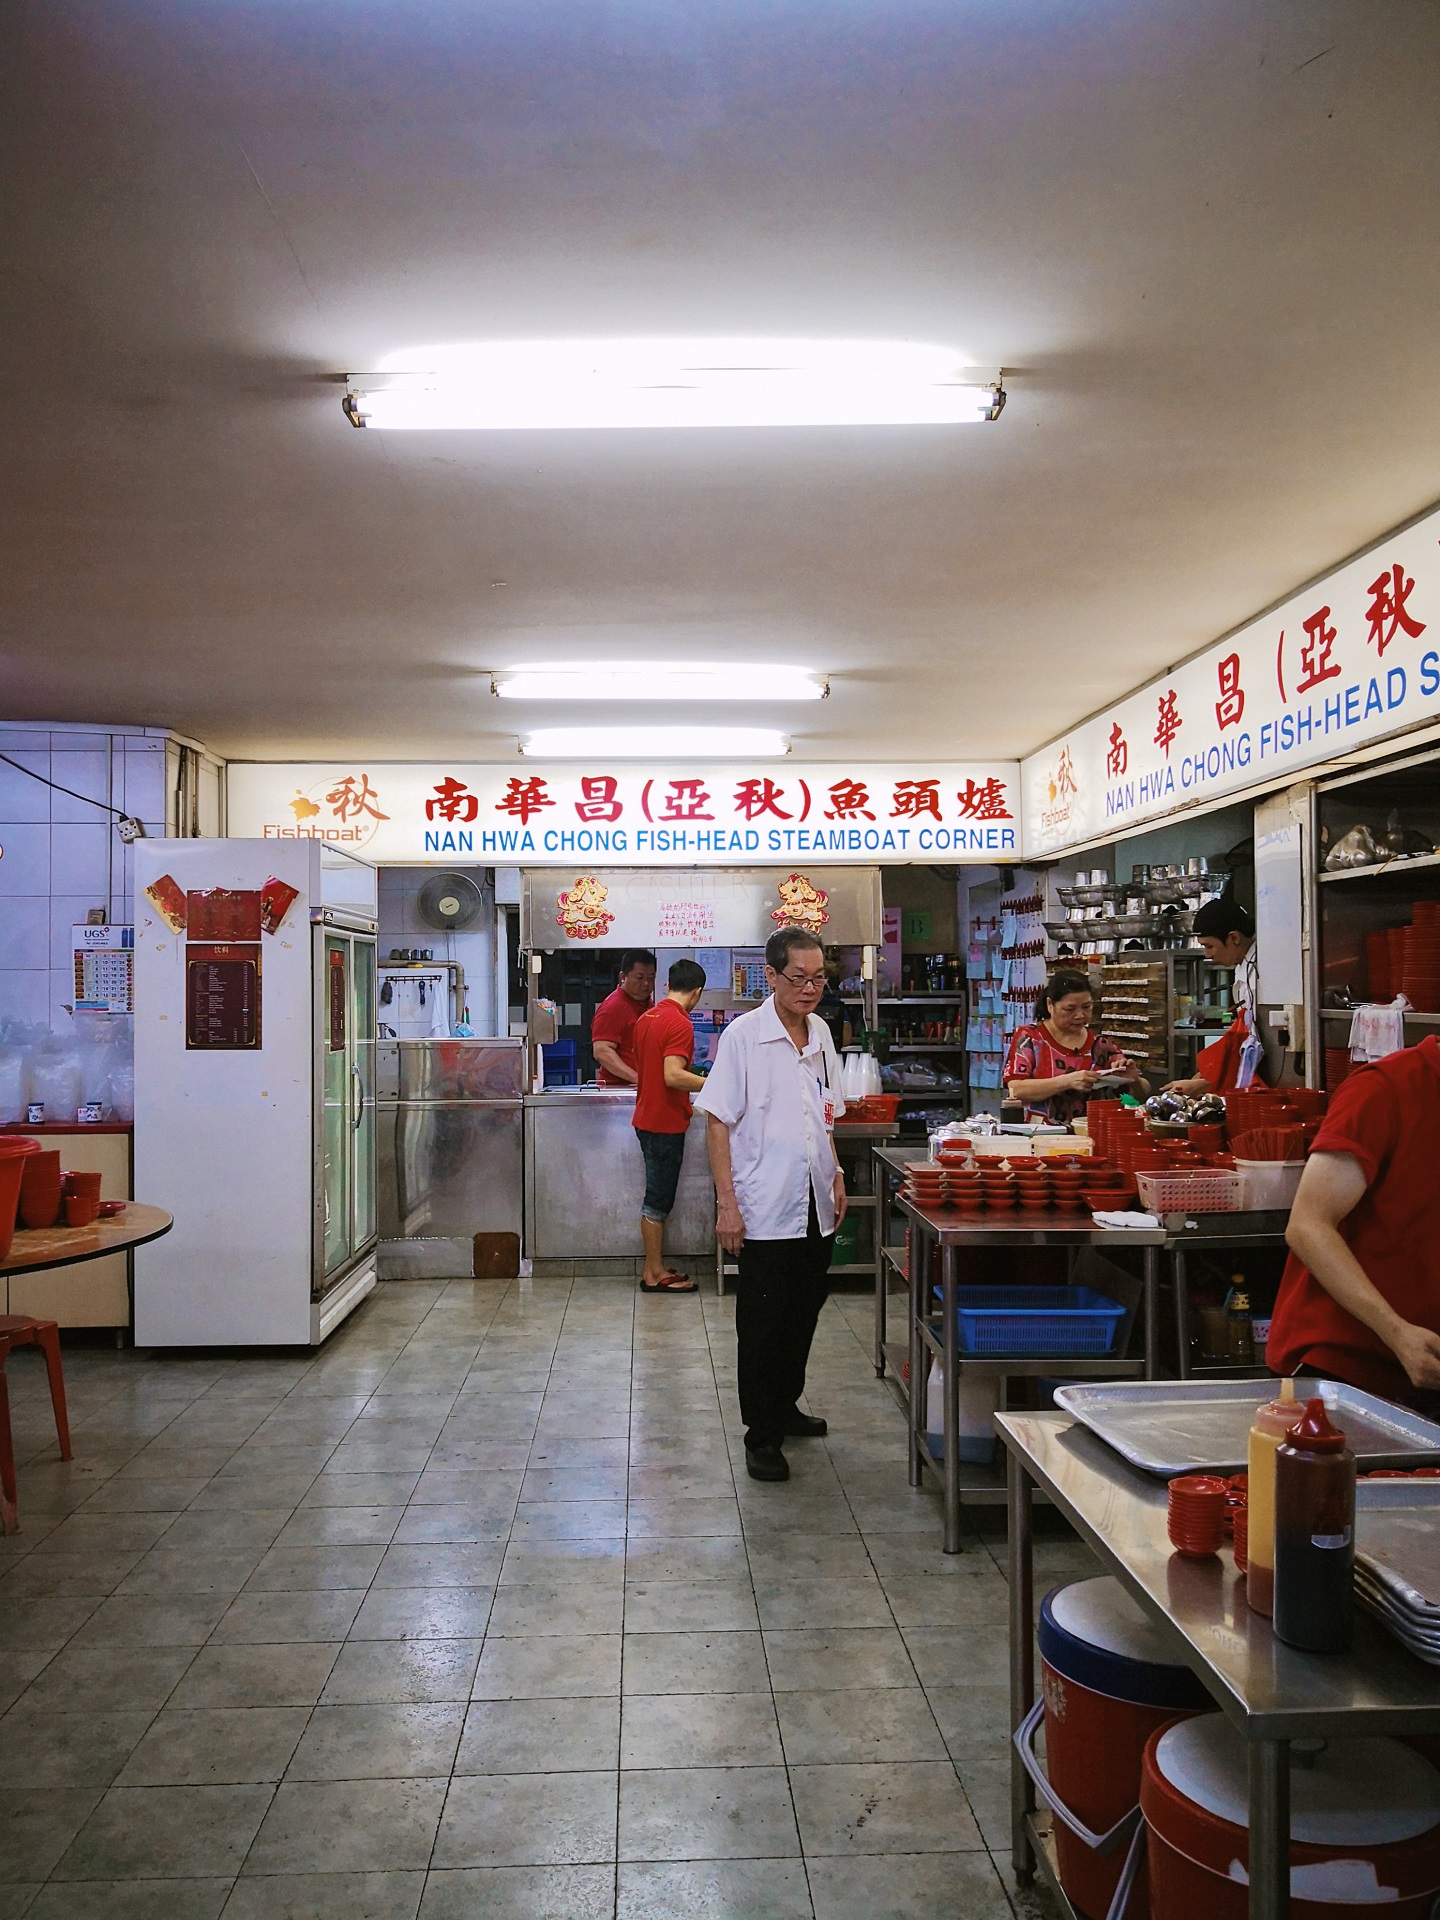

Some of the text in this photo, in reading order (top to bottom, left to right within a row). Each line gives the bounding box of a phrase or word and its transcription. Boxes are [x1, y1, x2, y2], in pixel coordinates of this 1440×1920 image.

[1107, 540, 1440, 780] 南華昌(亞秋
[1106, 781, 1135, 817] NAN
[1140, 765, 1175, 805] HWA
[1181, 732, 1251, 788] CHONG
[1260, 666, 1407, 759] FISH-HEAD
[1057, 744, 1078, 801] 秋
[325, 773, 391, 823] 秋
[263, 824, 363, 841] Fishboat
[425, 830, 473, 852] NAN
[482, 830, 536, 852] HWA
[543, 829, 628, 852] CHONG
[636, 829, 760, 852] FISH-HEAD
[768, 829, 911, 851] STEAMBOAT
[919, 828, 1016, 850] CORNER
[84, 929, 105, 938] UGS
